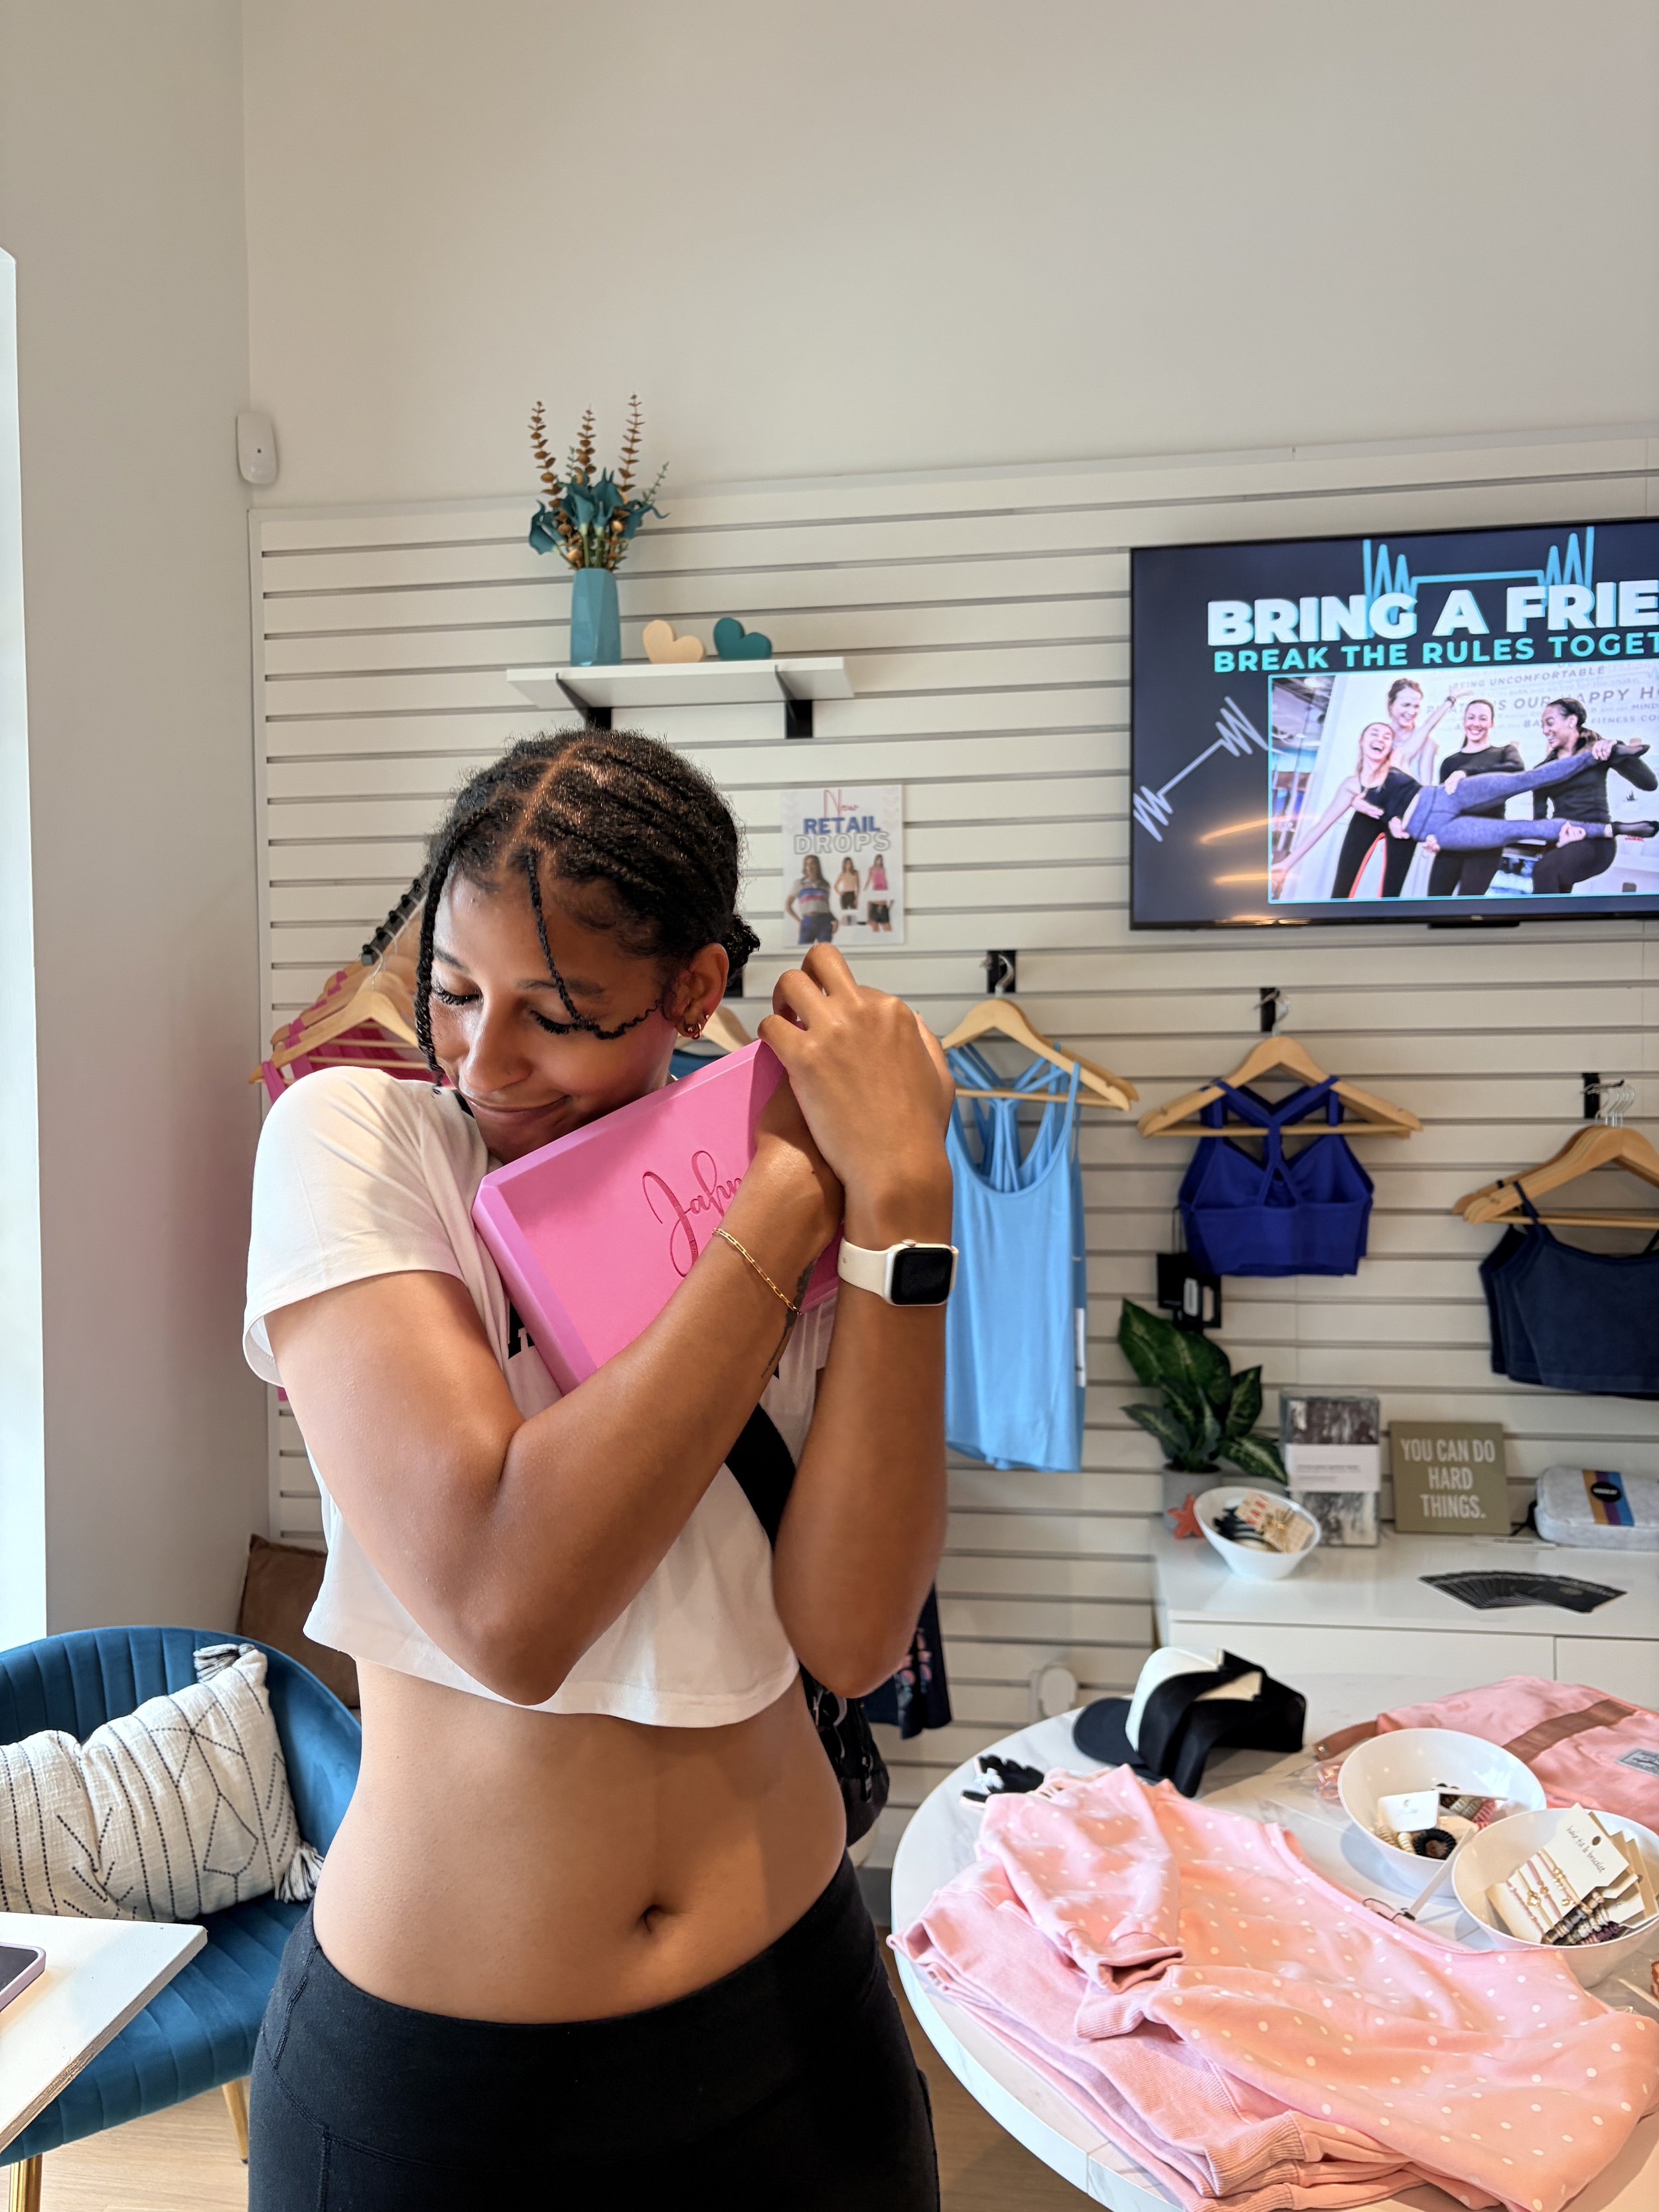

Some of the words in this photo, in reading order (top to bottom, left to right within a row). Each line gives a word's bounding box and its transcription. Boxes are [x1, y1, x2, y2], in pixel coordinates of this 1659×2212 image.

[1208, 592, 1417, 646] BRING
[1432, 589, 1490, 636] A
[1214, 646, 1329, 673] BREAK
[1340, 643, 1407, 668] THE
[1422, 638, 1535, 664] RULES
[1490, 665, 1606, 687] UNCOMFORTABLE
[1561, 688, 1630, 704] APPY
[803, 816, 881, 835] RETAIL
[794, 831, 891, 855] DROPS
[1400, 1438, 1433, 1462] YOU
[1436, 1438, 1469, 1462] CAN
[1473, 1439, 1496, 1463] DO
[1428, 1466, 1473, 1490] HARD
[1419, 1494, 1486, 1519] THINGS.
